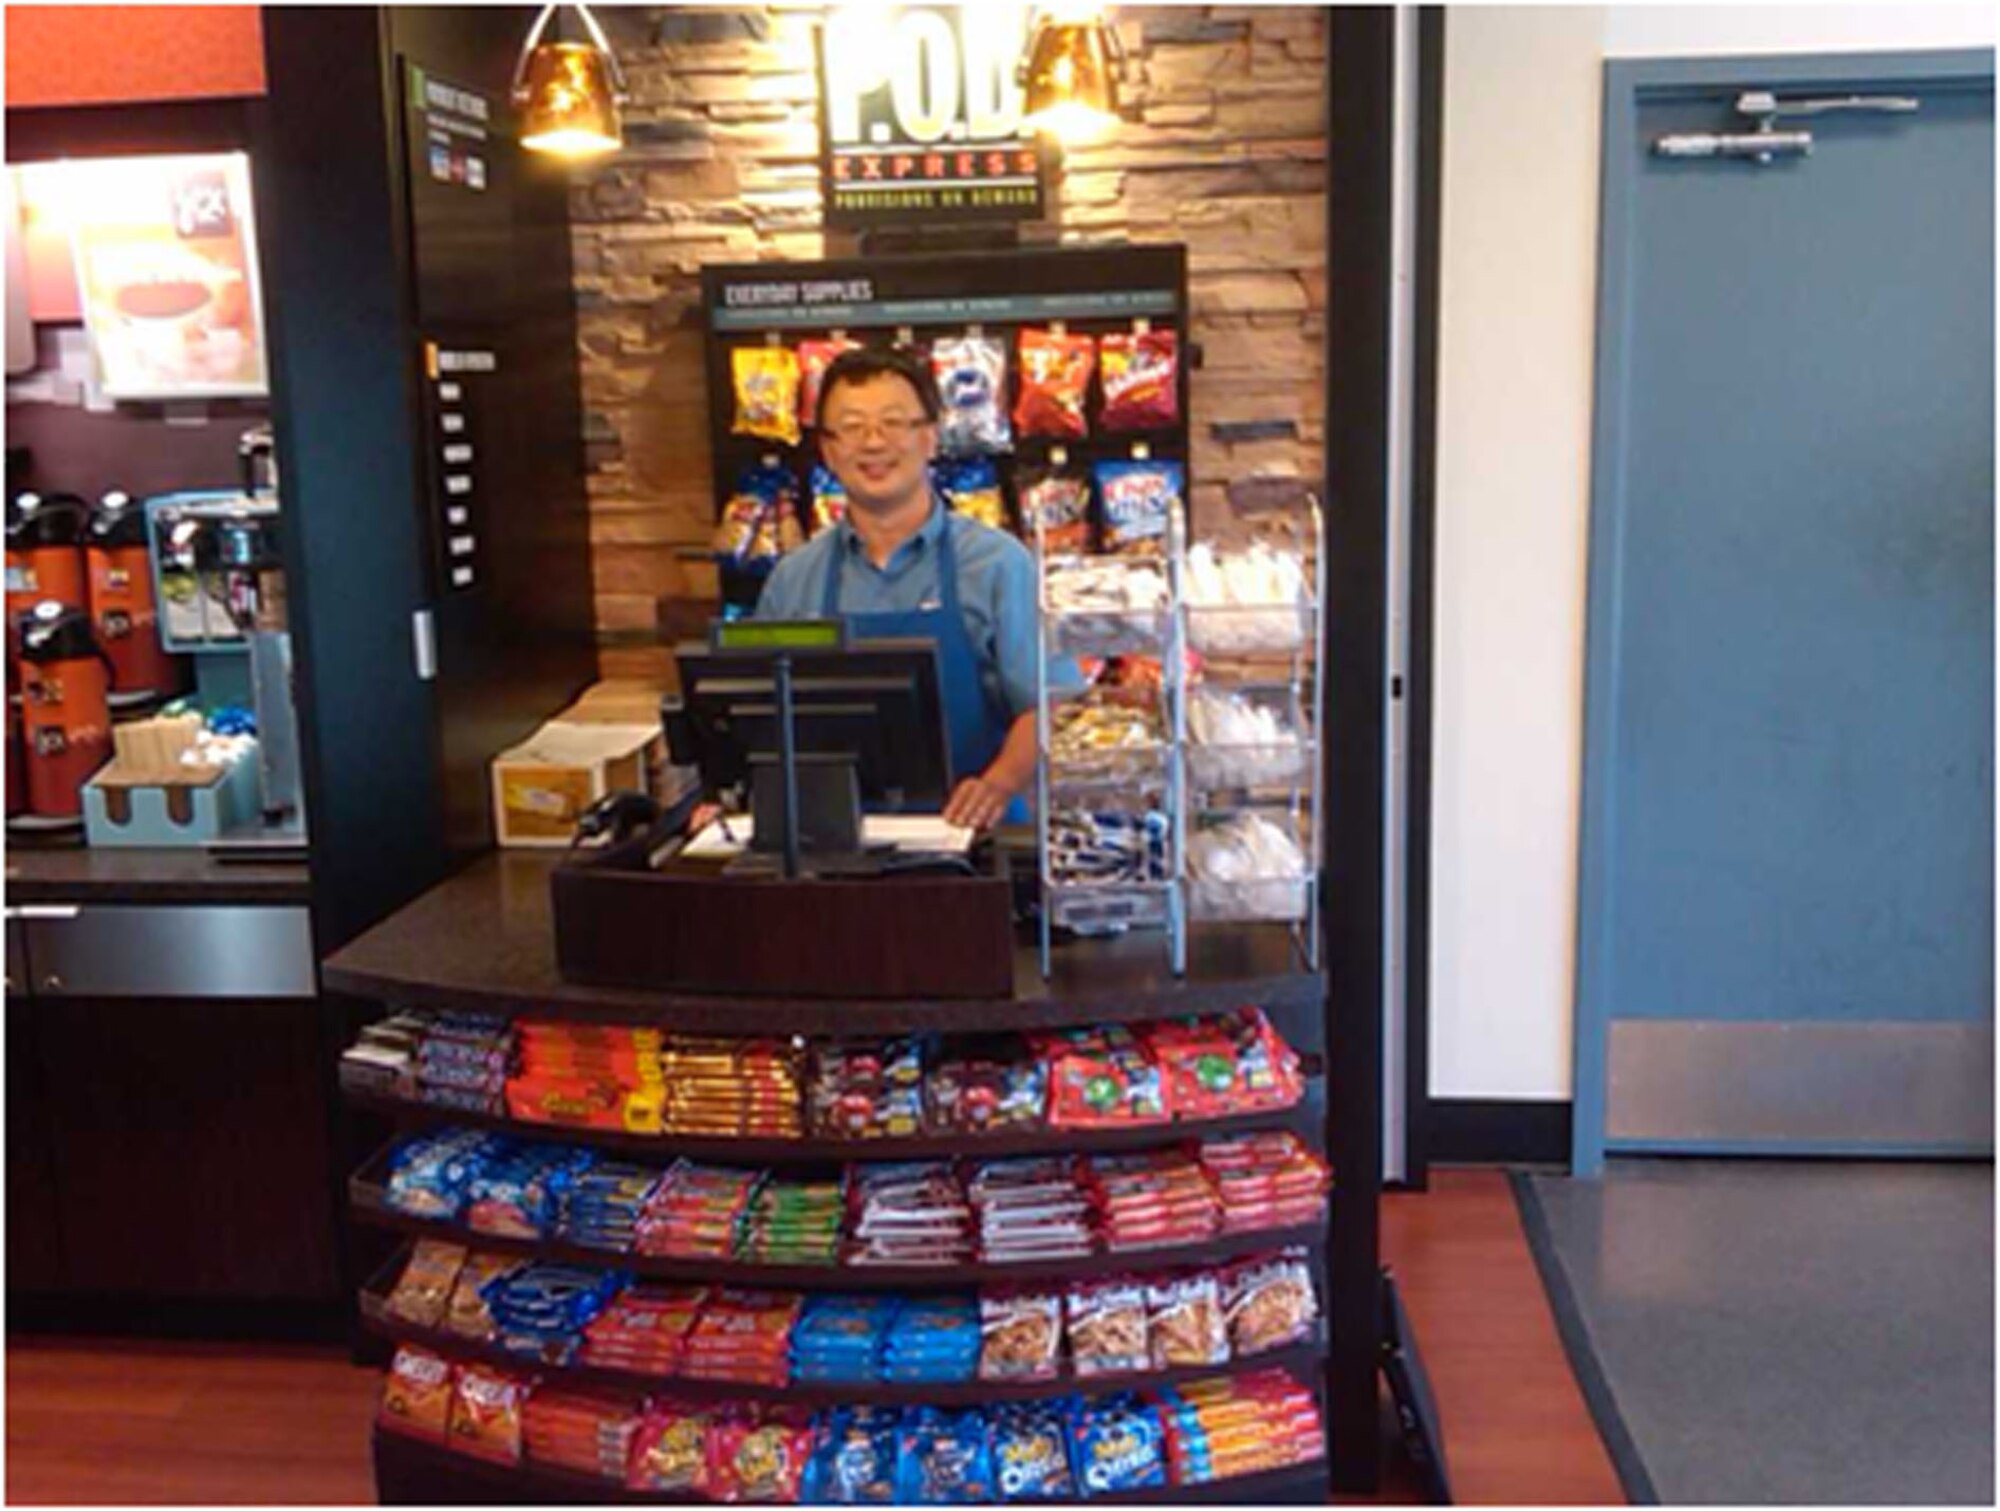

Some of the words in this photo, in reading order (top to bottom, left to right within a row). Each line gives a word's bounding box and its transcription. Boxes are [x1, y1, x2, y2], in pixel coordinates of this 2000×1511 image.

[831, 151, 1038, 180] EXPRESS
[724, 283, 798, 306] EVERYDAY
[800, 279, 874, 303] SUPPLIES
